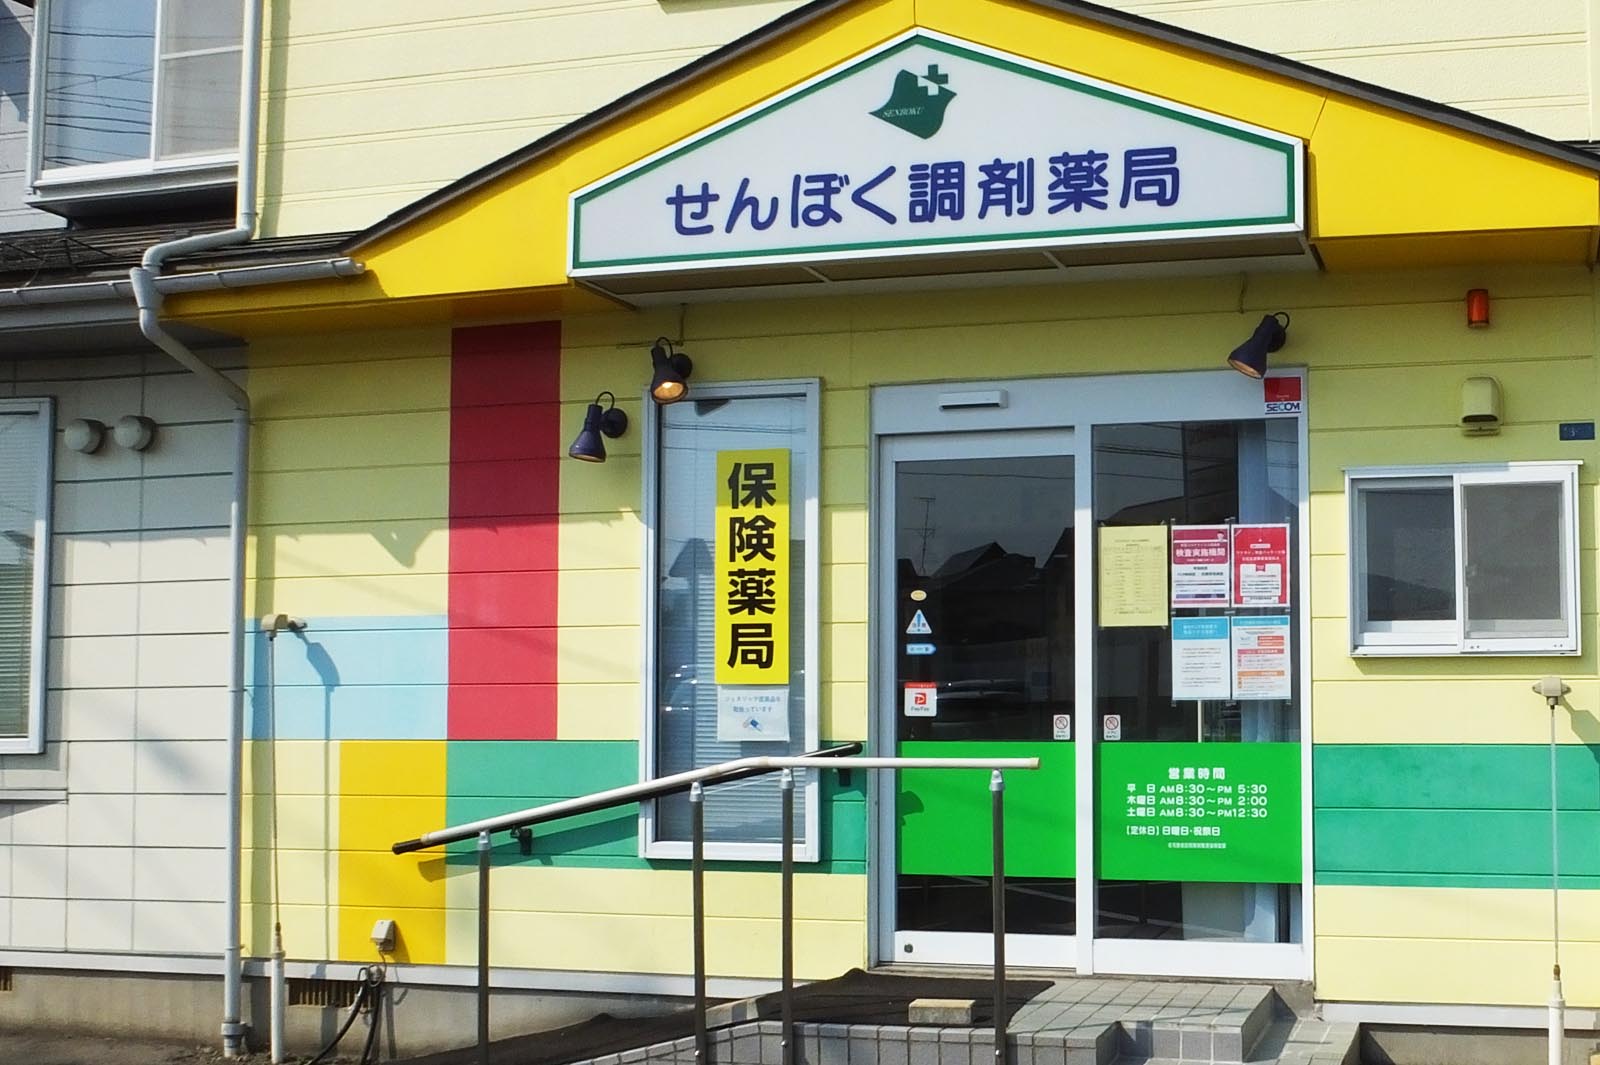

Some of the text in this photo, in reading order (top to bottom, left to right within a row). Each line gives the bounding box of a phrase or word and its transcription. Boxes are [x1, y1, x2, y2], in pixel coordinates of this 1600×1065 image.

[665, 146, 1180, 237] せんぼく調剤薬局
[1266, 402, 1300, 412] SECOM
[727, 462, 777, 670] 保険薬局
[1168, 767, 1226, 780] 営業時間
[1126, 795, 1156, 805] 木曜日
[1126, 807, 1156, 817] 土曜日
